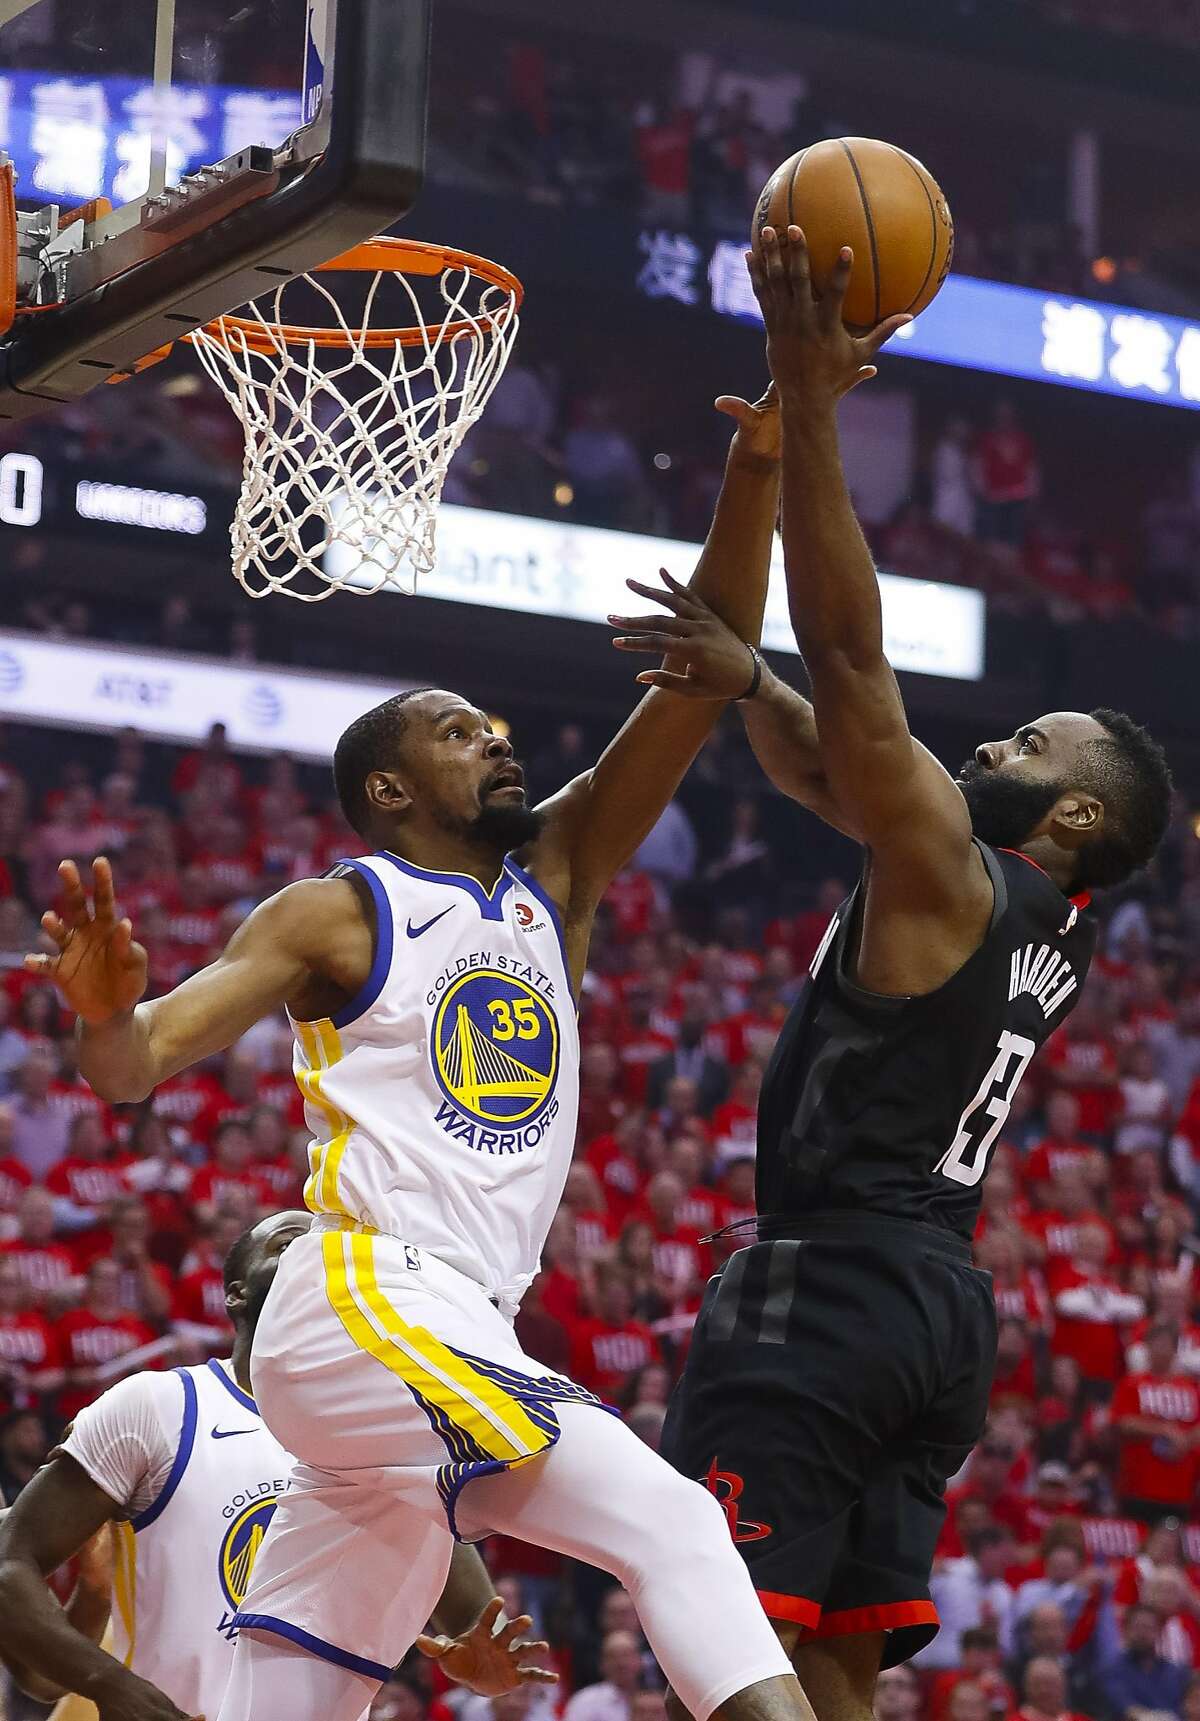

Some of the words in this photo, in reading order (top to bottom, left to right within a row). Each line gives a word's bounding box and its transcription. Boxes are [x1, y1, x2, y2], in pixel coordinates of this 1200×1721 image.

[521, 922, 546, 933] kuten
[426, 951, 491, 1006] GOLDEN
[497, 956, 556, 999] STATE
[1008, 943, 1077, 1020] HARDEN
[487, 997, 541, 1041] 35
[434, 1096, 560, 1155] WARRIORS
